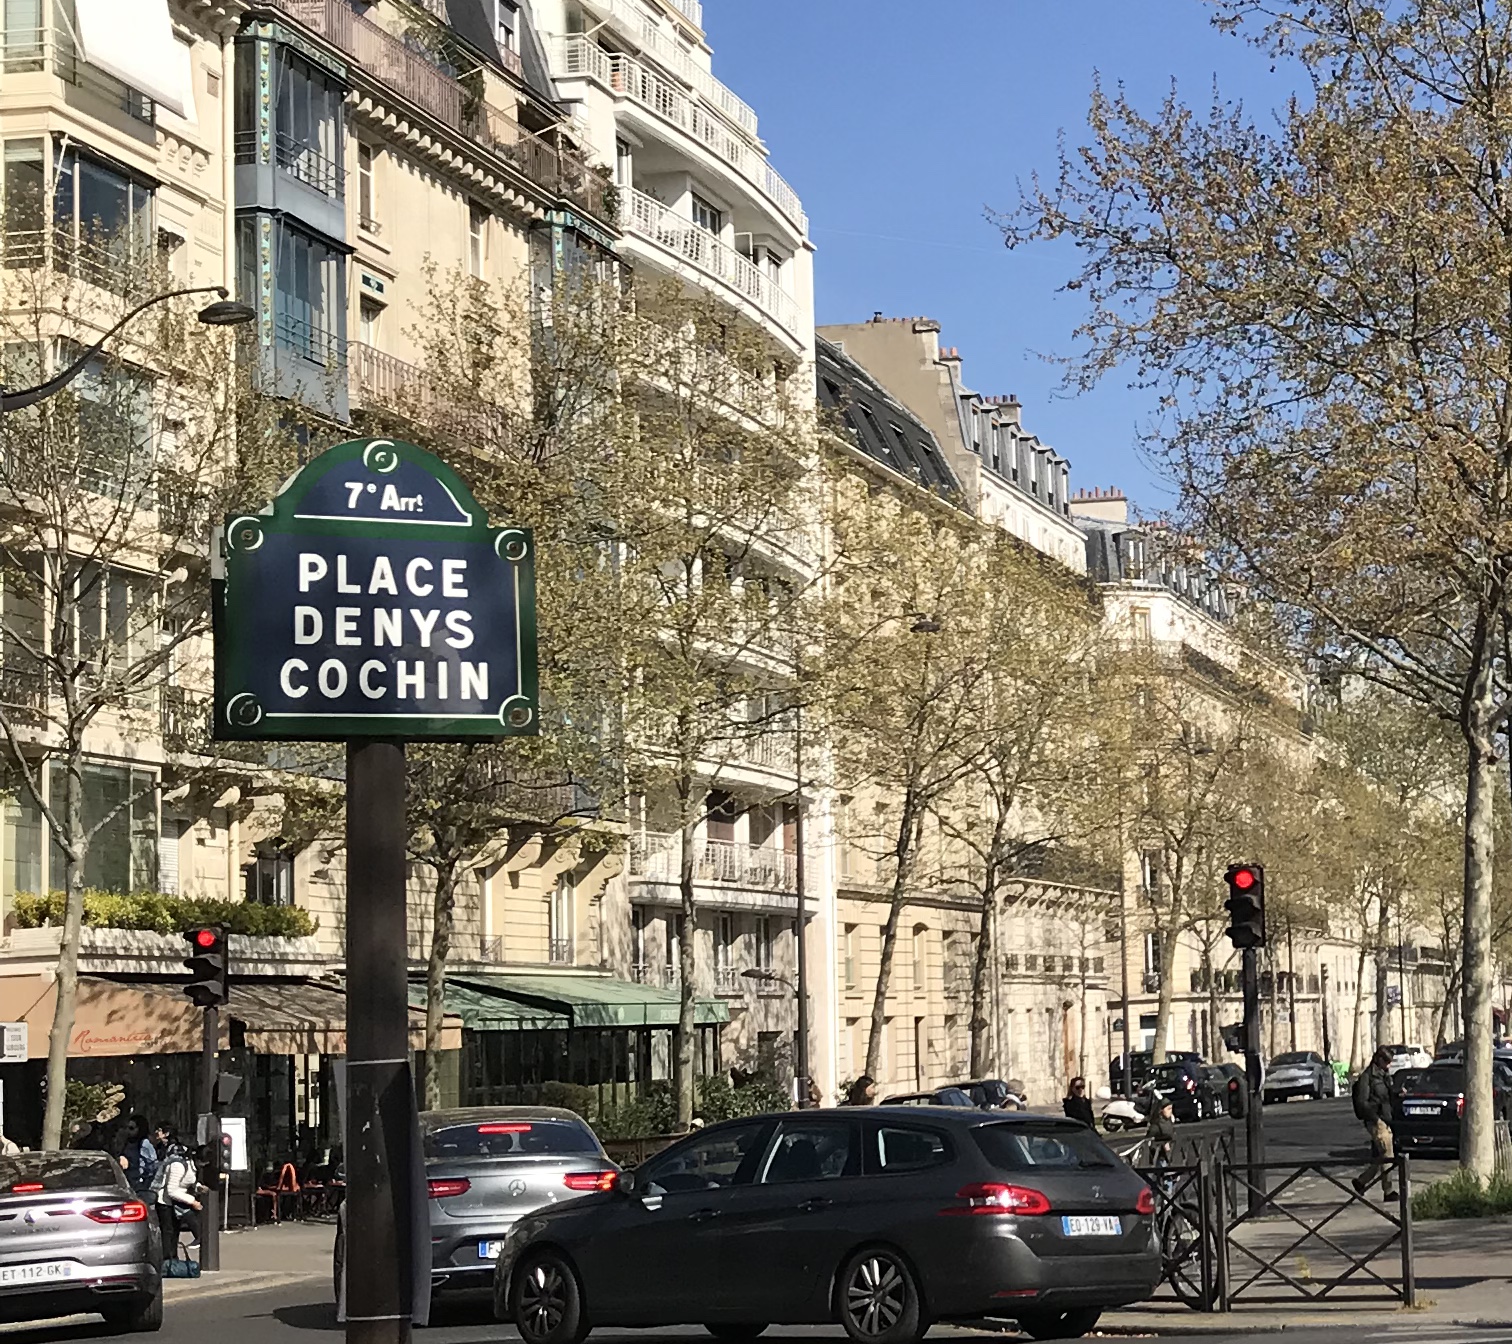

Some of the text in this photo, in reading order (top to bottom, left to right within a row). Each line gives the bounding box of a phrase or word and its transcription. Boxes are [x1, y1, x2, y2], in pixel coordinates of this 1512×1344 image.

[298, 552, 469, 598] PLACE
[294, 605, 475, 650] DENYS
[279, 658, 489, 701] COCHIN
